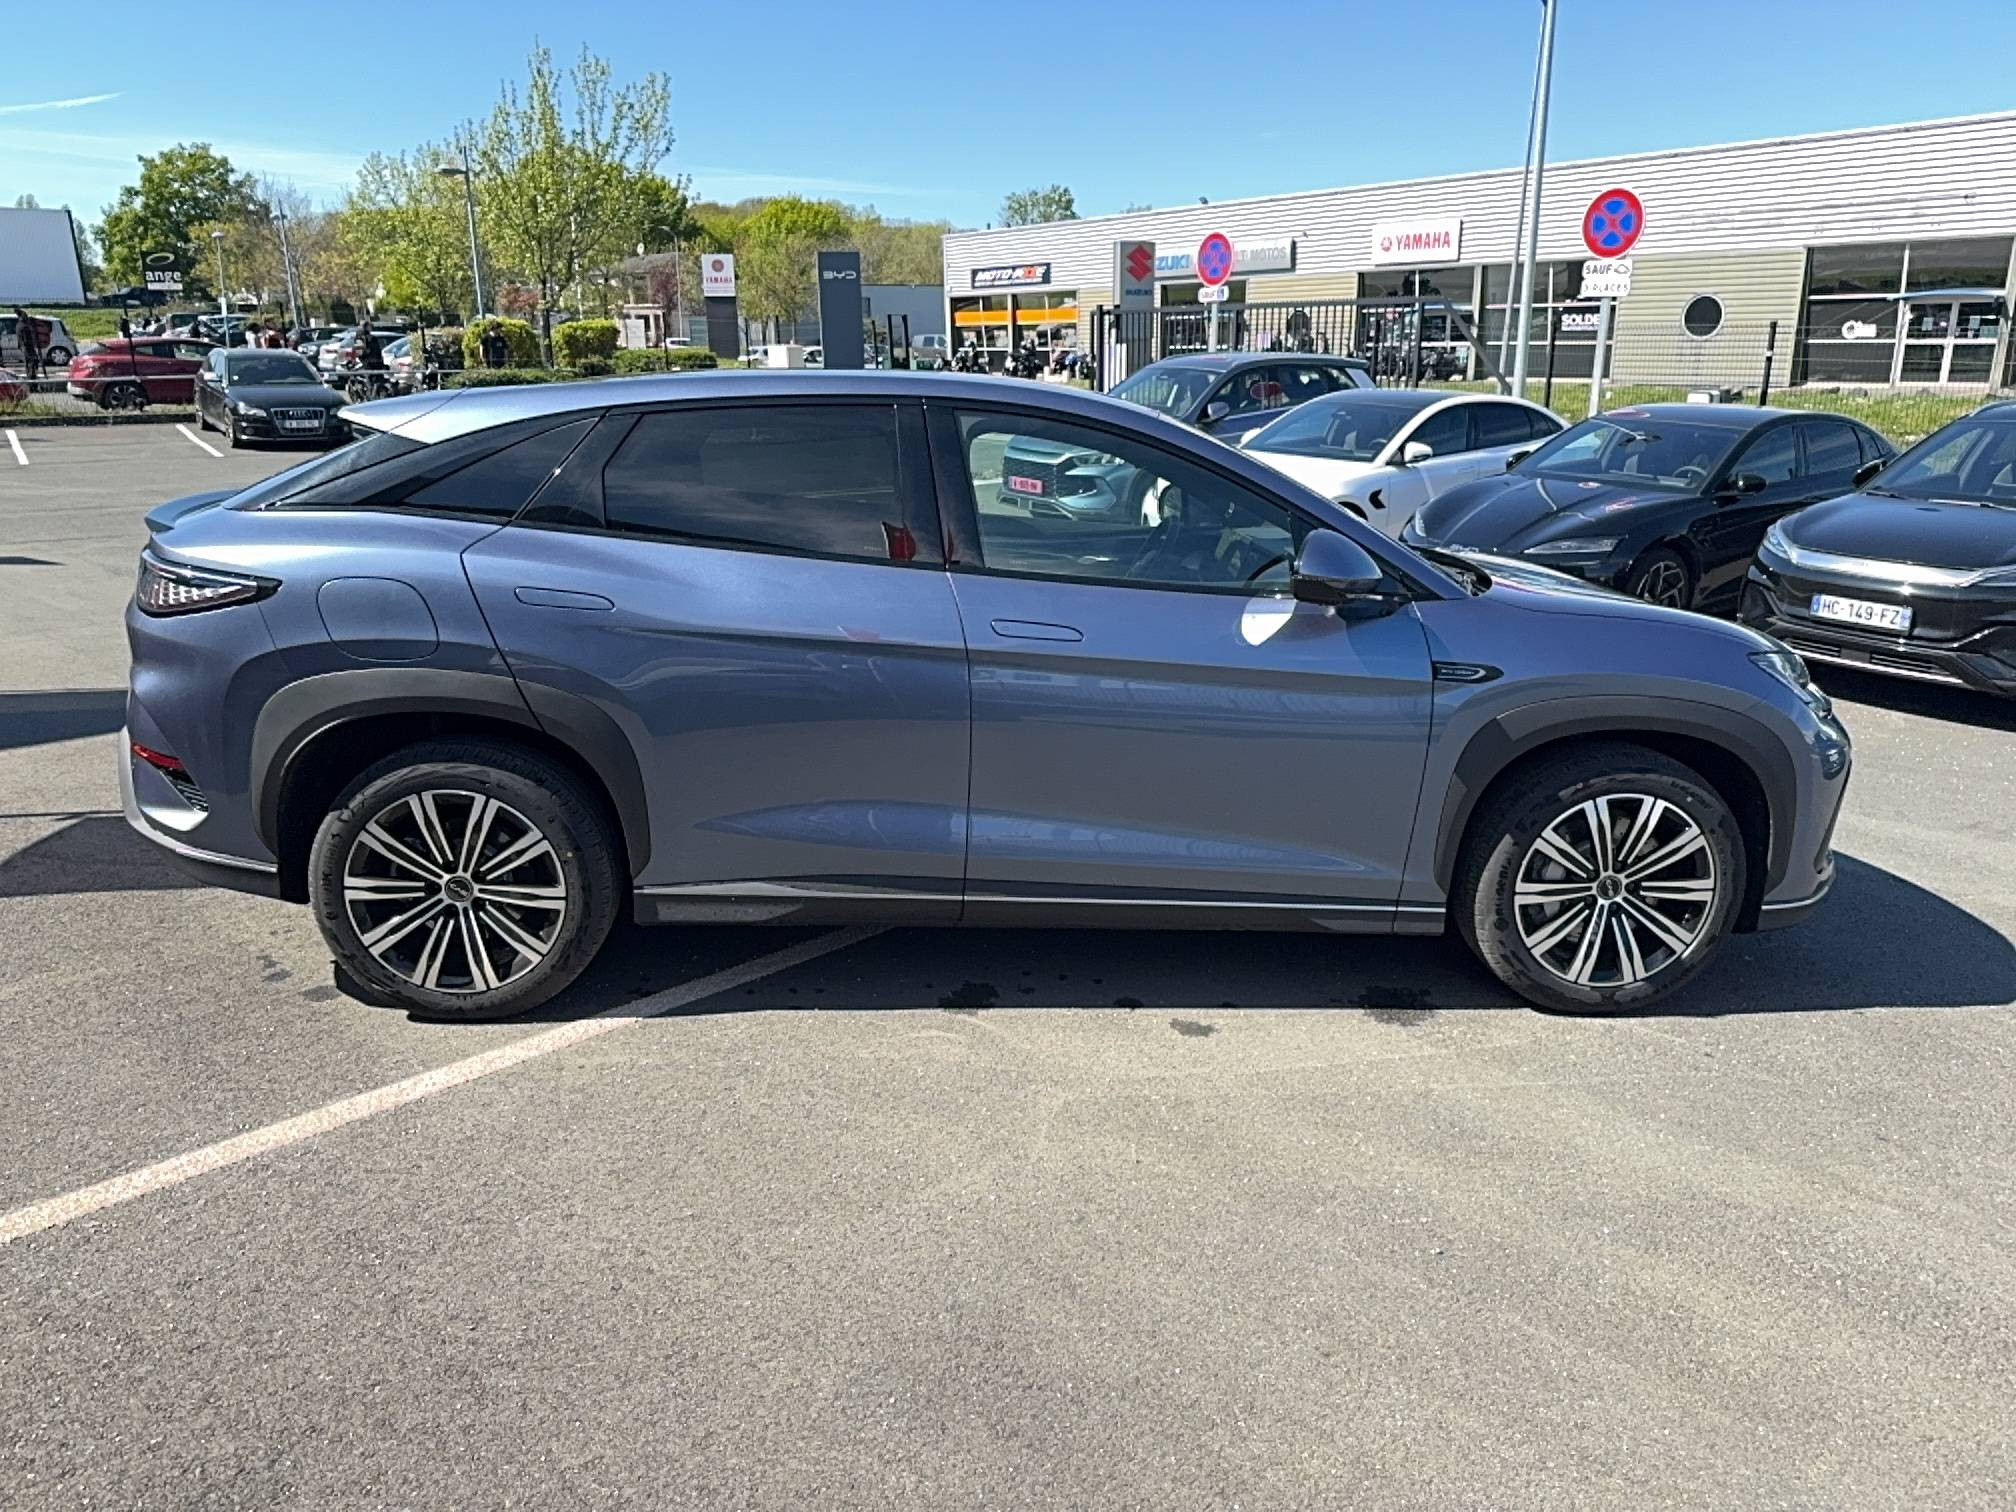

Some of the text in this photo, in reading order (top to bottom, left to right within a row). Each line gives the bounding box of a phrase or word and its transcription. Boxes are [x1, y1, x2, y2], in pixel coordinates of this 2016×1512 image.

[1396, 231, 1451, 252] YAMAHA
[1156, 254, 1190, 271] ZUKI
[823, 270, 857, 280] BYD
[1585, 264, 1612, 275] SAUF
[145, 271, 182, 284] ange
[705, 275, 733, 284] YAMAHA
[1822, 599, 1900, 625] HC-149-FZ
